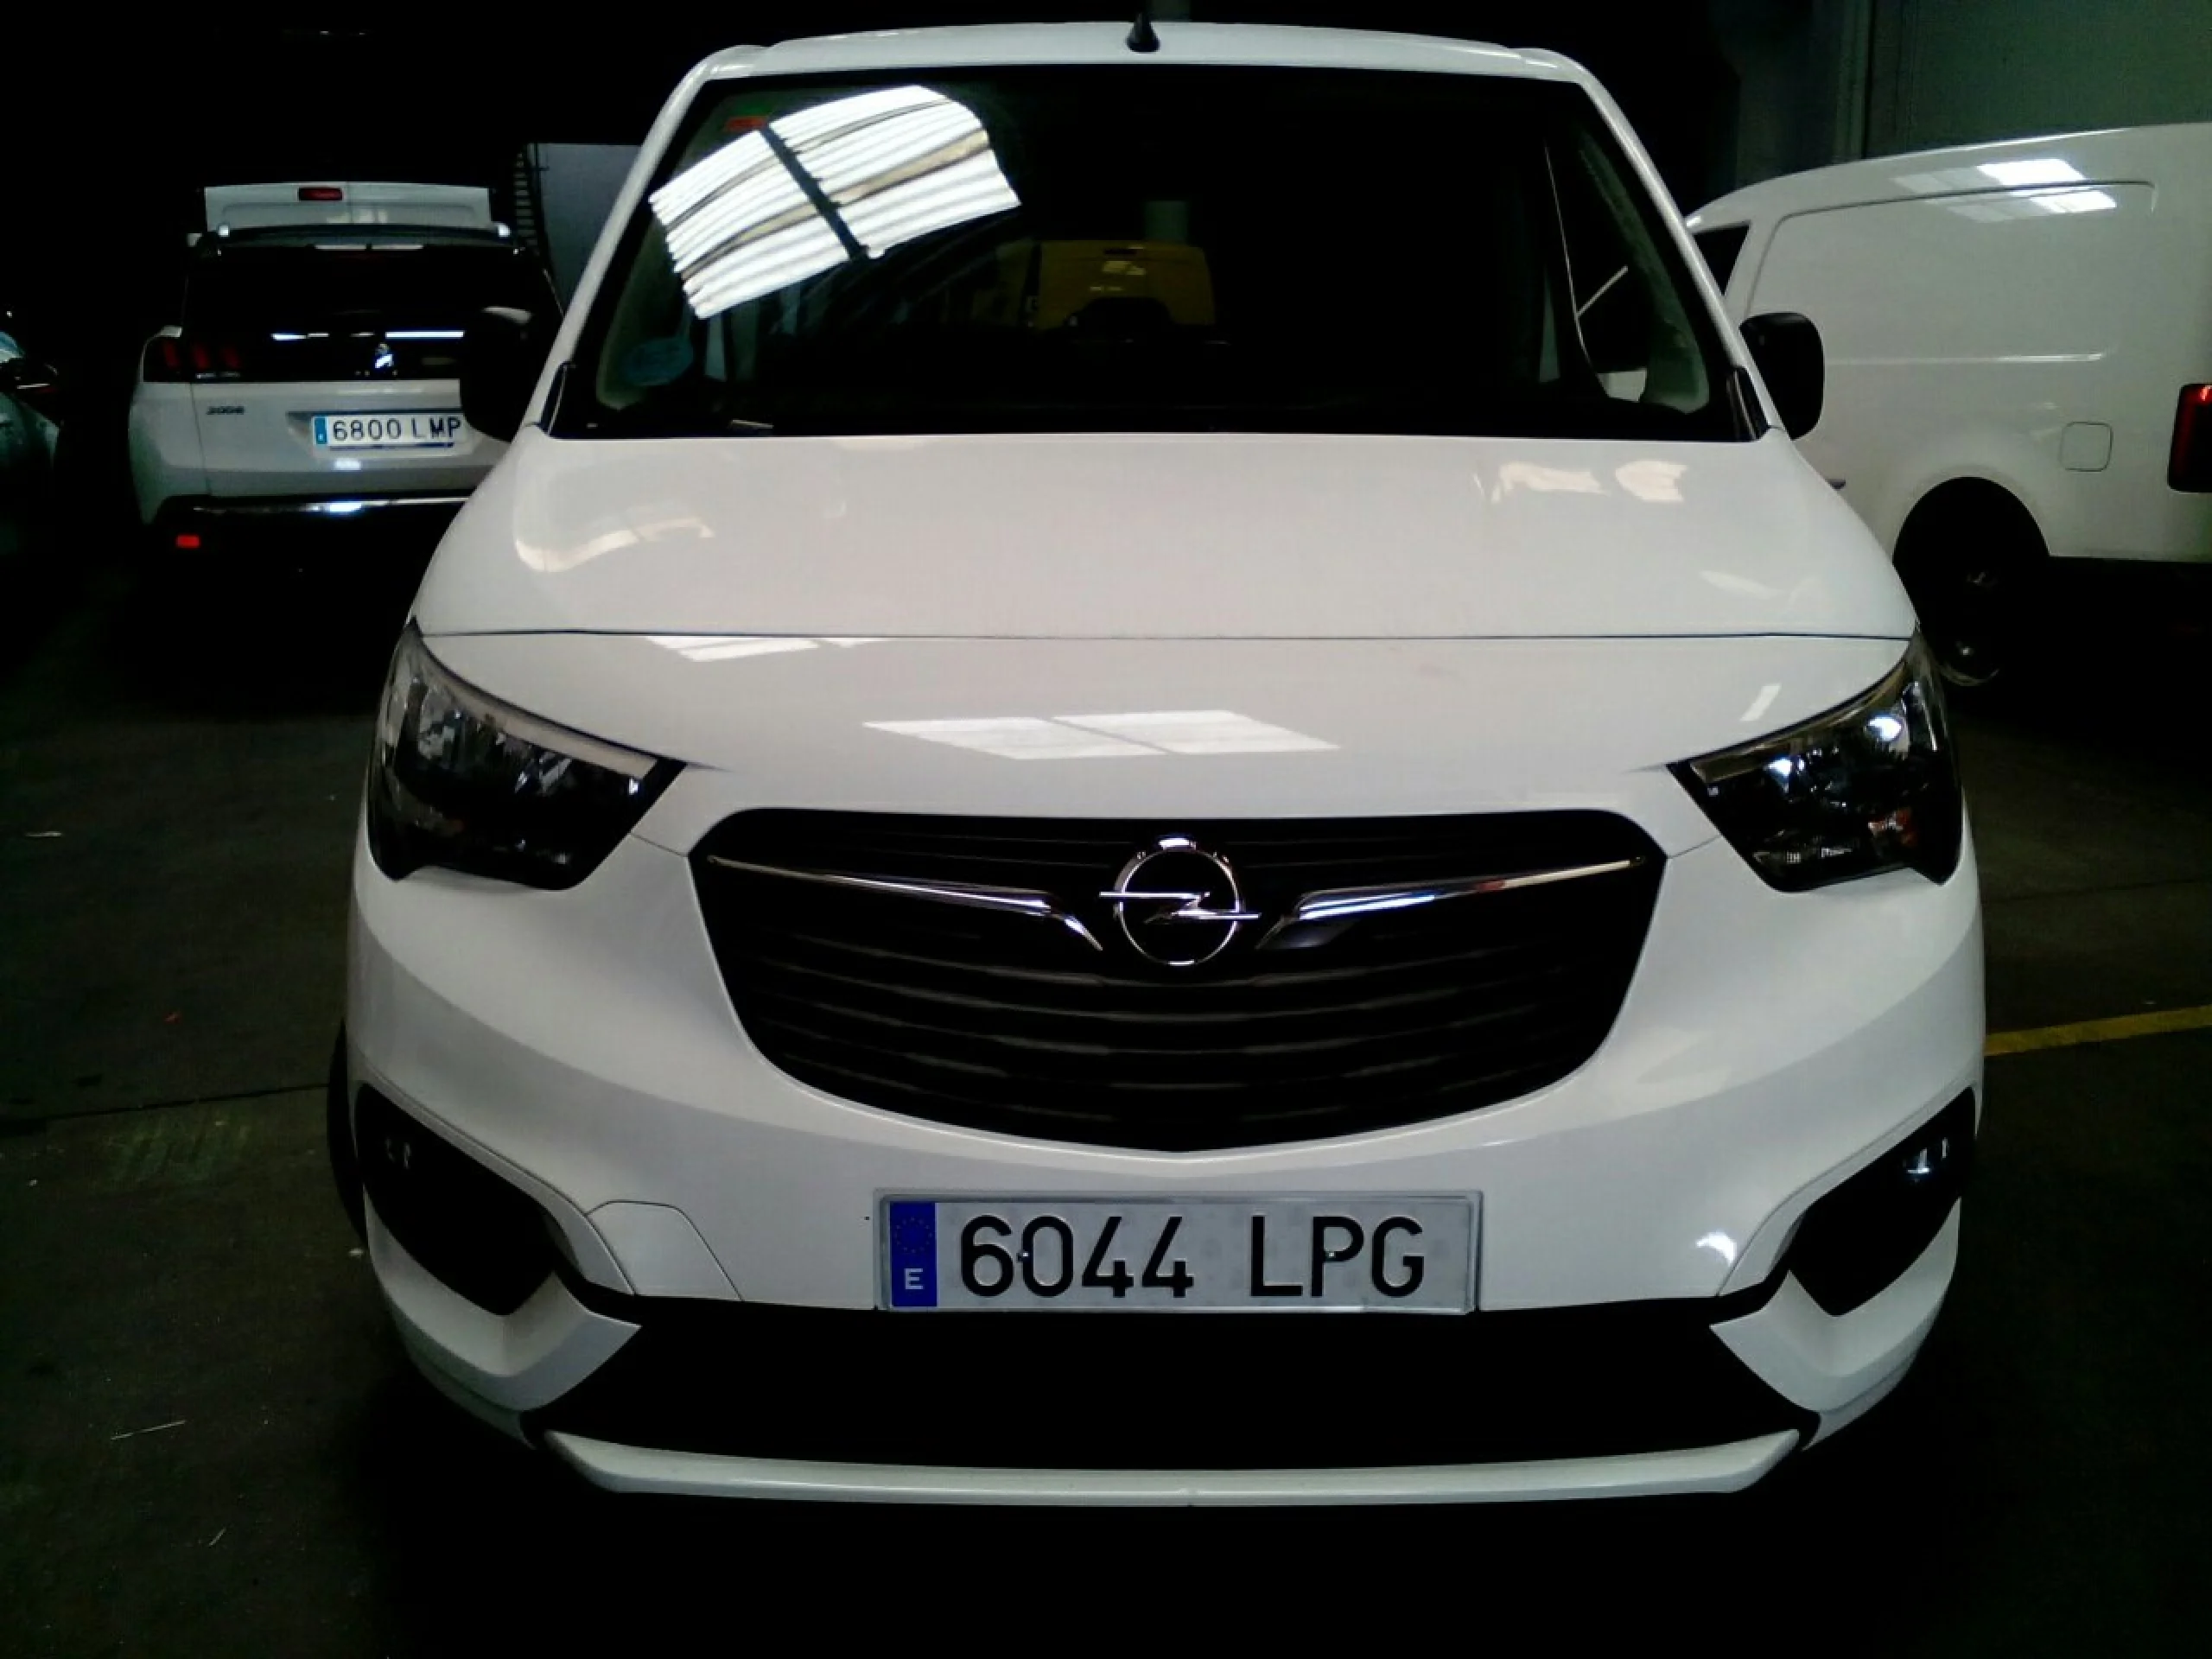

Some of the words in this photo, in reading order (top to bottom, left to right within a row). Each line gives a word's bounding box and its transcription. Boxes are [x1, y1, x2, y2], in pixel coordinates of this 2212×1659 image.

[333, 418, 402, 442] 6800
[411, 416, 461, 440] LMP
[961, 1214, 1195, 1298] 6044
[1249, 1214, 1426, 1299] LPG
[904, 1267, 925, 1290] E
